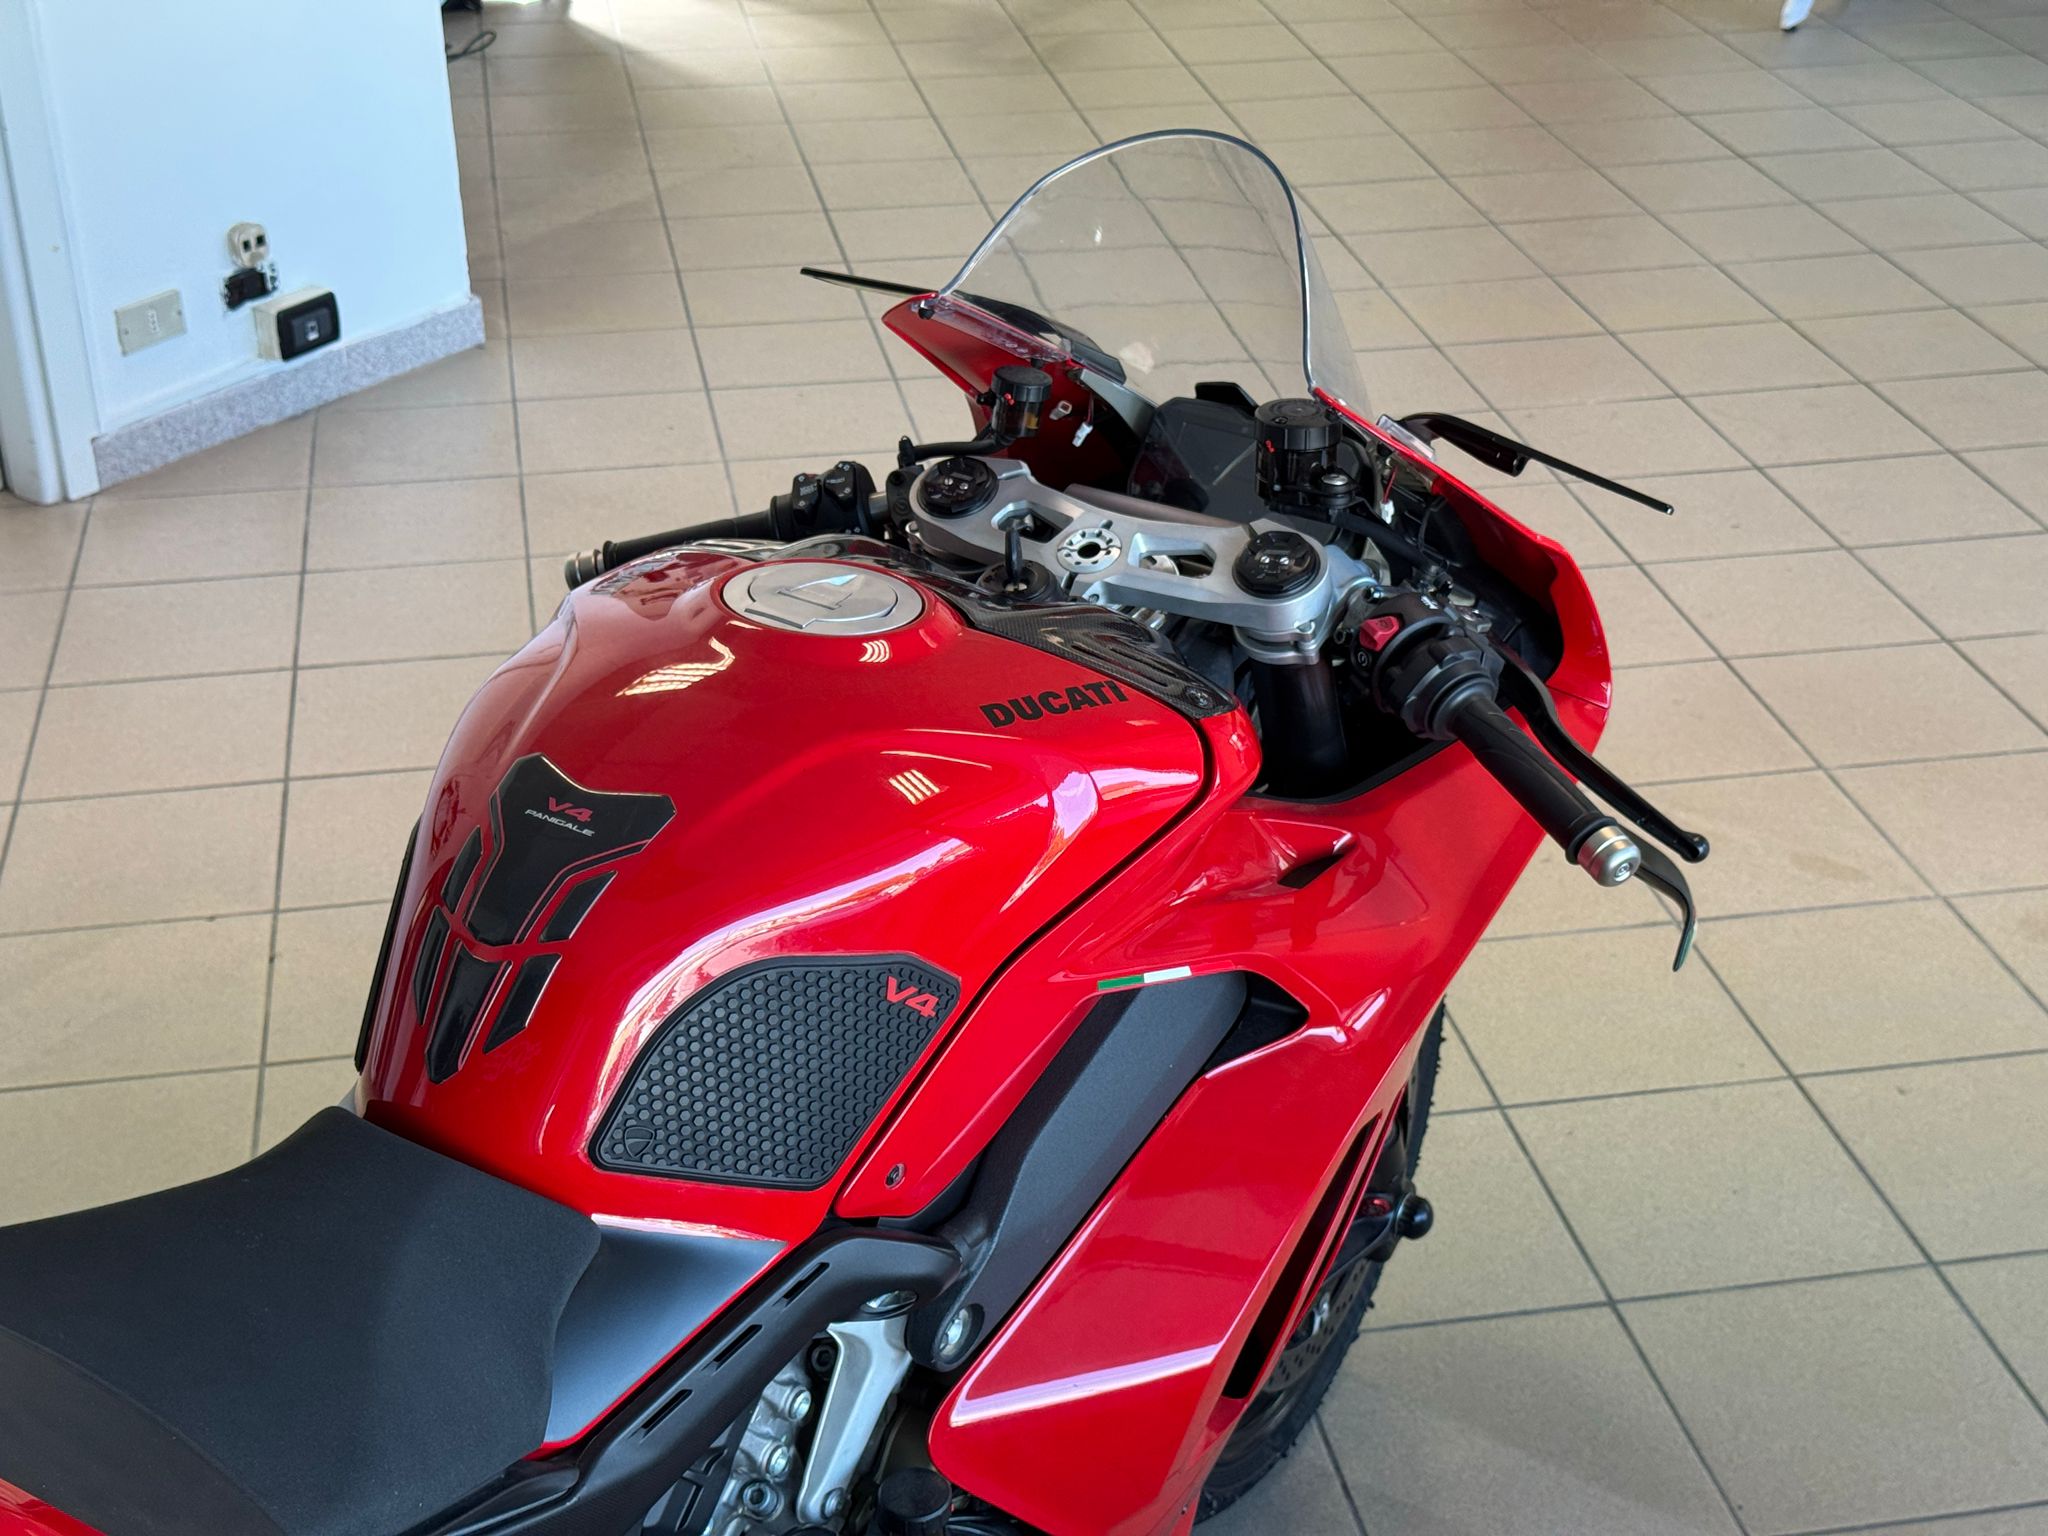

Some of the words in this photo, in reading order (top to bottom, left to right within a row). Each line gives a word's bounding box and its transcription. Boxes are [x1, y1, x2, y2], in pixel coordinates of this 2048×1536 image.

[980, 680, 1129, 728] DUCATI
[524, 808, 595, 837] PANIGALE
[548, 797, 594, 822] V4
[886, 975, 939, 1018] V4
